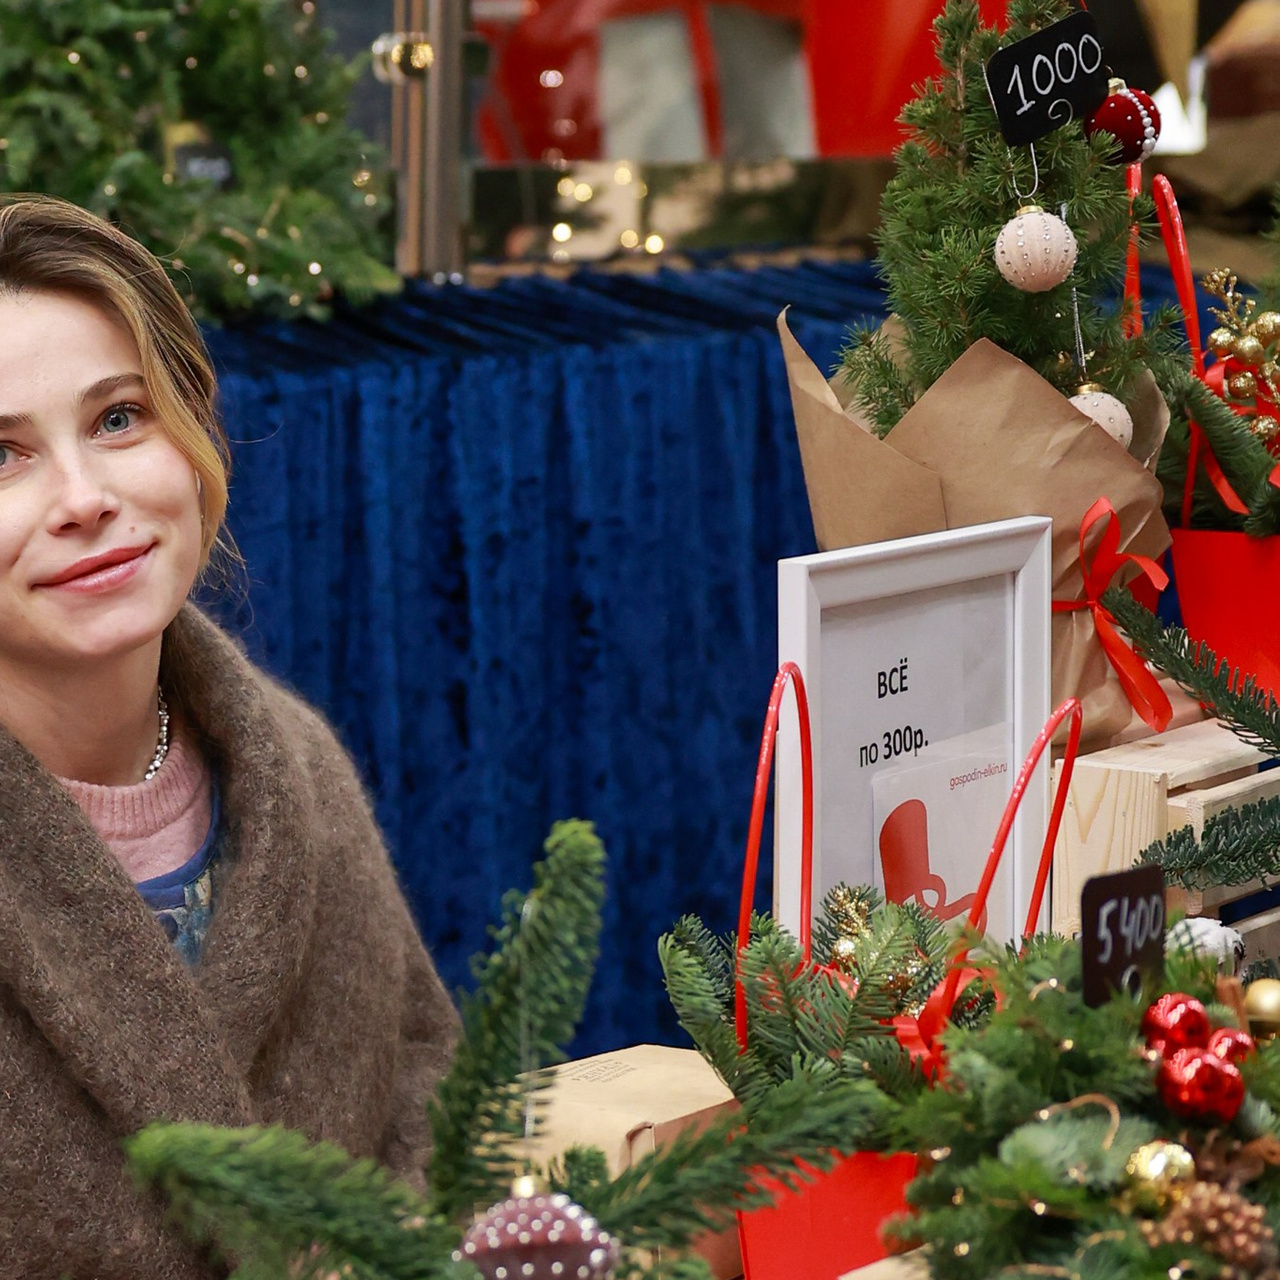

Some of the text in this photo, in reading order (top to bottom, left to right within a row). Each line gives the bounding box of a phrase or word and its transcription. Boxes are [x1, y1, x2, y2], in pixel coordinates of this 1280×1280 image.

[1006, 33, 1102, 116] 1000
[877, 657, 909, 699] ВСЁ
[859, 725, 929, 768] по 300р.
[949, 762, 1008, 791] gospodin-elkin.ru
